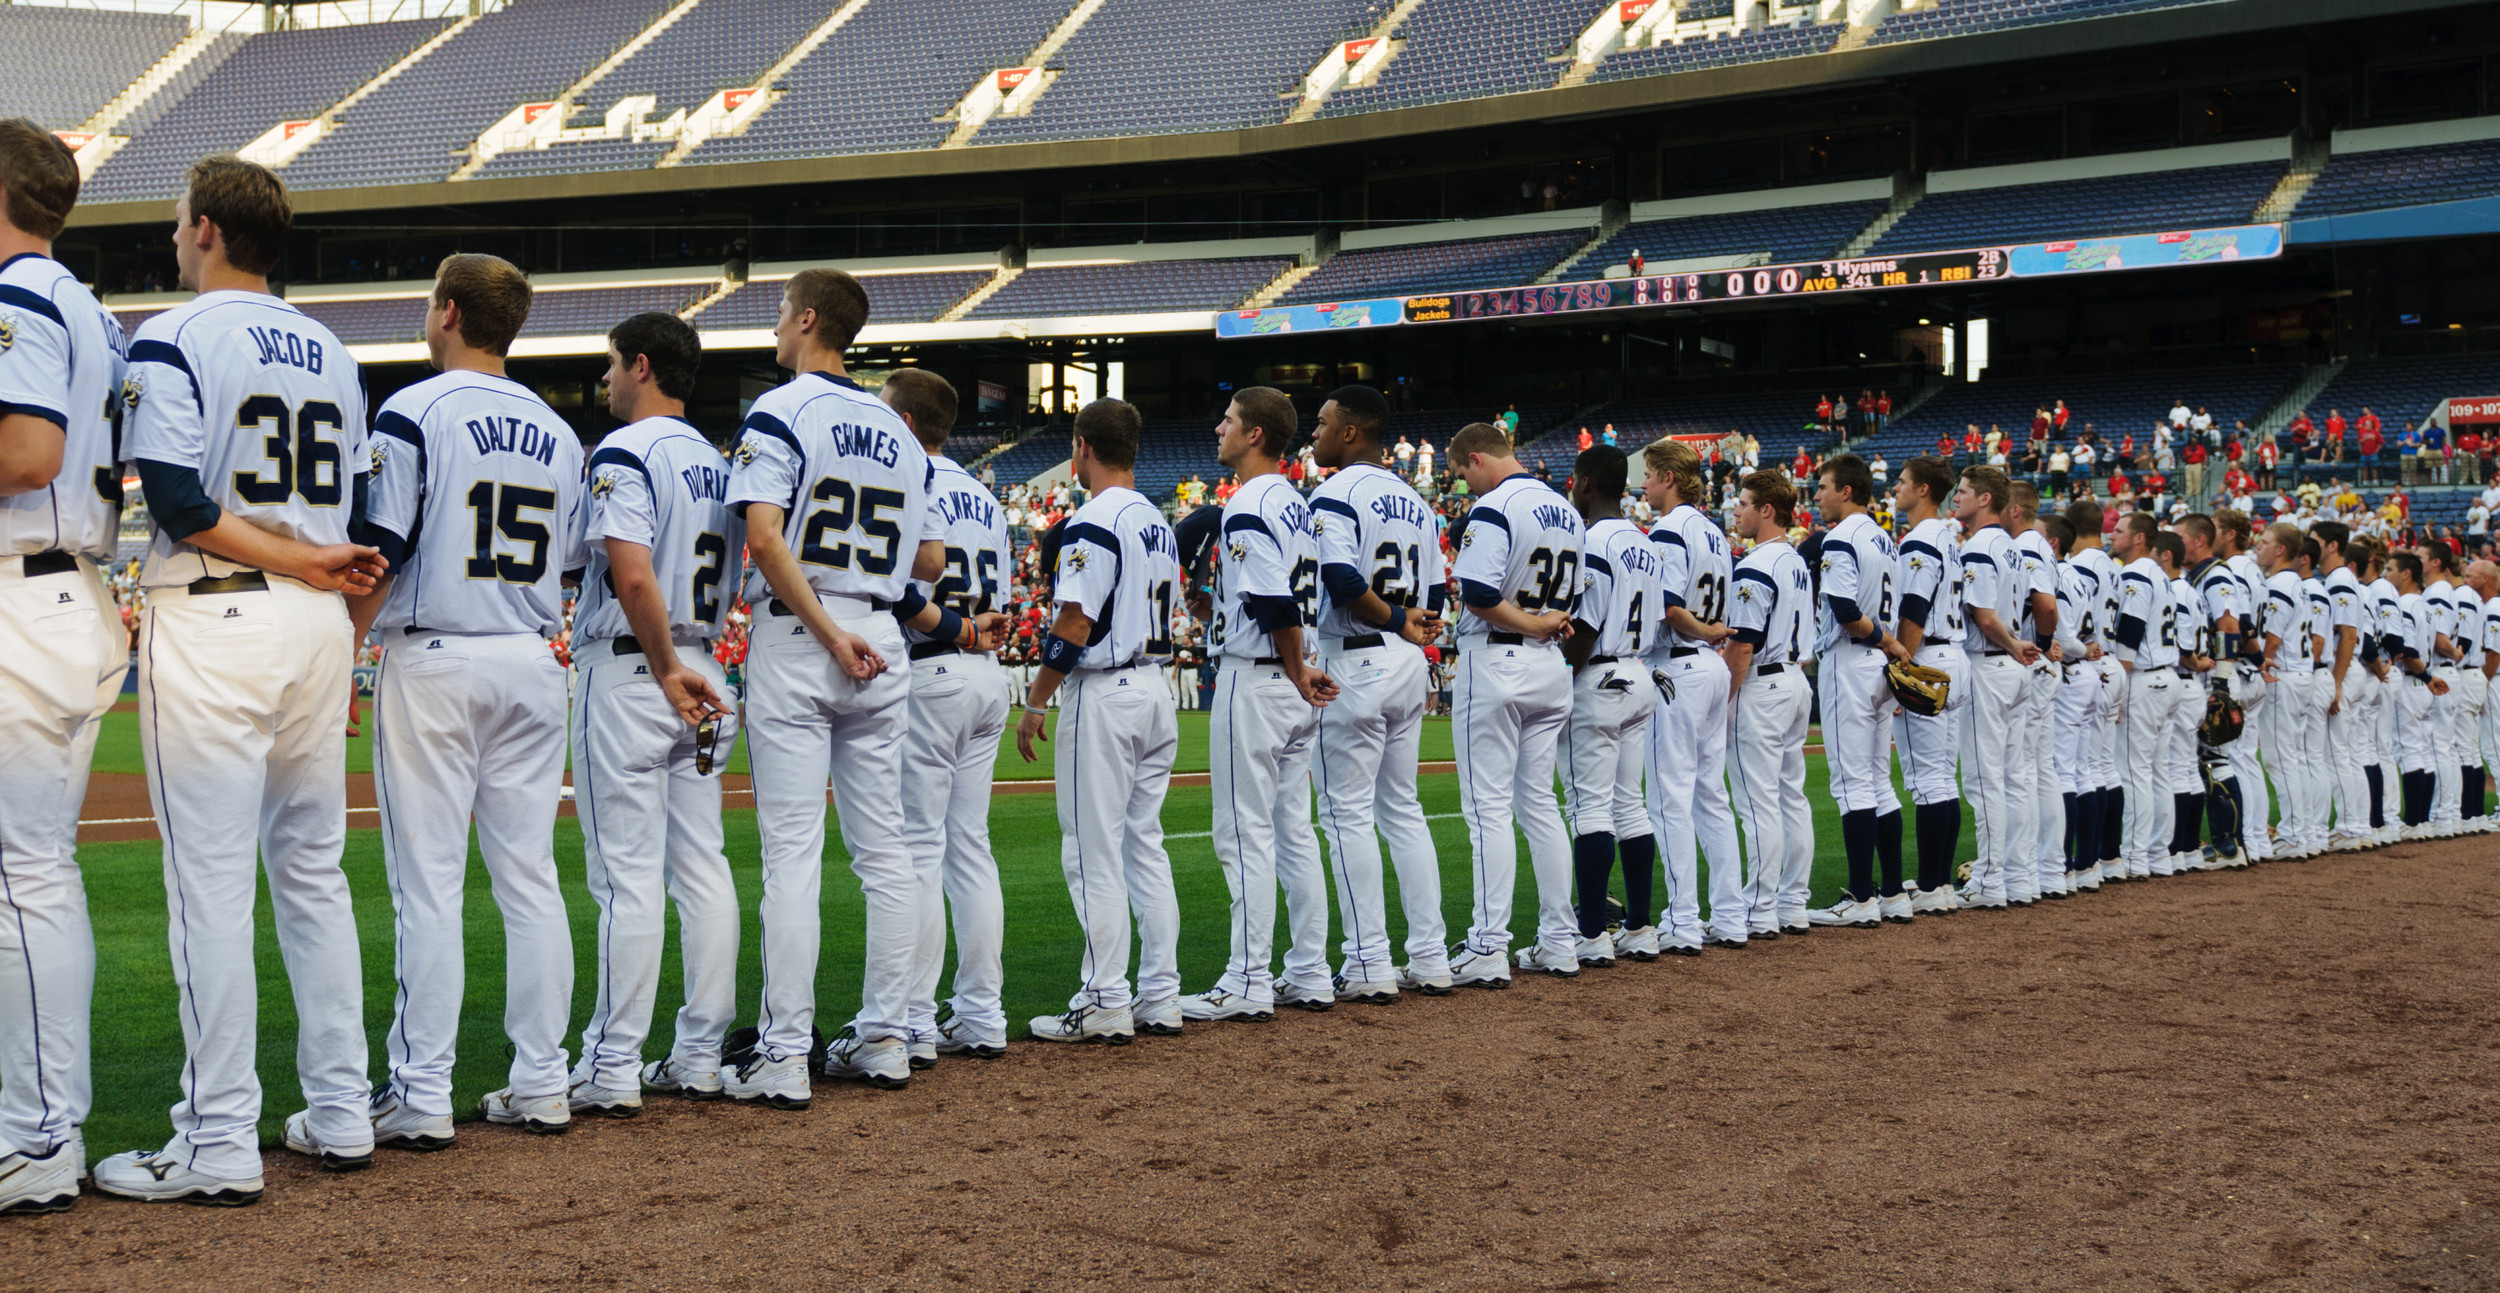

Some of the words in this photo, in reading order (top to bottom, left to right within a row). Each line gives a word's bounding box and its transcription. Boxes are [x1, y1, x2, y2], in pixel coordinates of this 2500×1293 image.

[1803, 277, 1838, 292] AVG
[1842, 275, 1873, 289] .341
[1883, 272, 1907, 286] HR
[1920, 270, 1928, 282] 1
[1941, 266, 1971, 281] RBI
[1978, 265, 1997, 279] 23
[1822, 264, 1832, 277] 3
[1837, 260, 1897, 278] Hyams
[1978, 251, 2000, 265] 2B
[1408, 296, 1450, 308] Bulldogs
[1413, 309, 1450, 322] Jackets
[1454, 296, 1464, 318] 1
[1470, 294, 1483, 317] 2
[1488, 293, 1501, 315] 3
[1504, 290, 1519, 314] 4
[1523, 290, 1537, 312] 5
[1541, 287, 1555, 311] 6
[1560, 286, 1573, 309] 7
[1577, 284, 1592, 309] 8
[1595, 283, 1611, 307] 9
[246, 326, 323, 376] JACOB
[2450, 404, 2473, 417] 109
[234, 394, 344, 507] 36
[466, 416, 557, 467] DALTON
[465, 480, 556, 585] 15
[800, 476, 905, 577] 25
[1532, 504, 1576, 536] FARMER
[1370, 541, 1419, 608] 21
[1517, 547, 1577, 611] 30
[1878, 571, 1893, 625] 6
